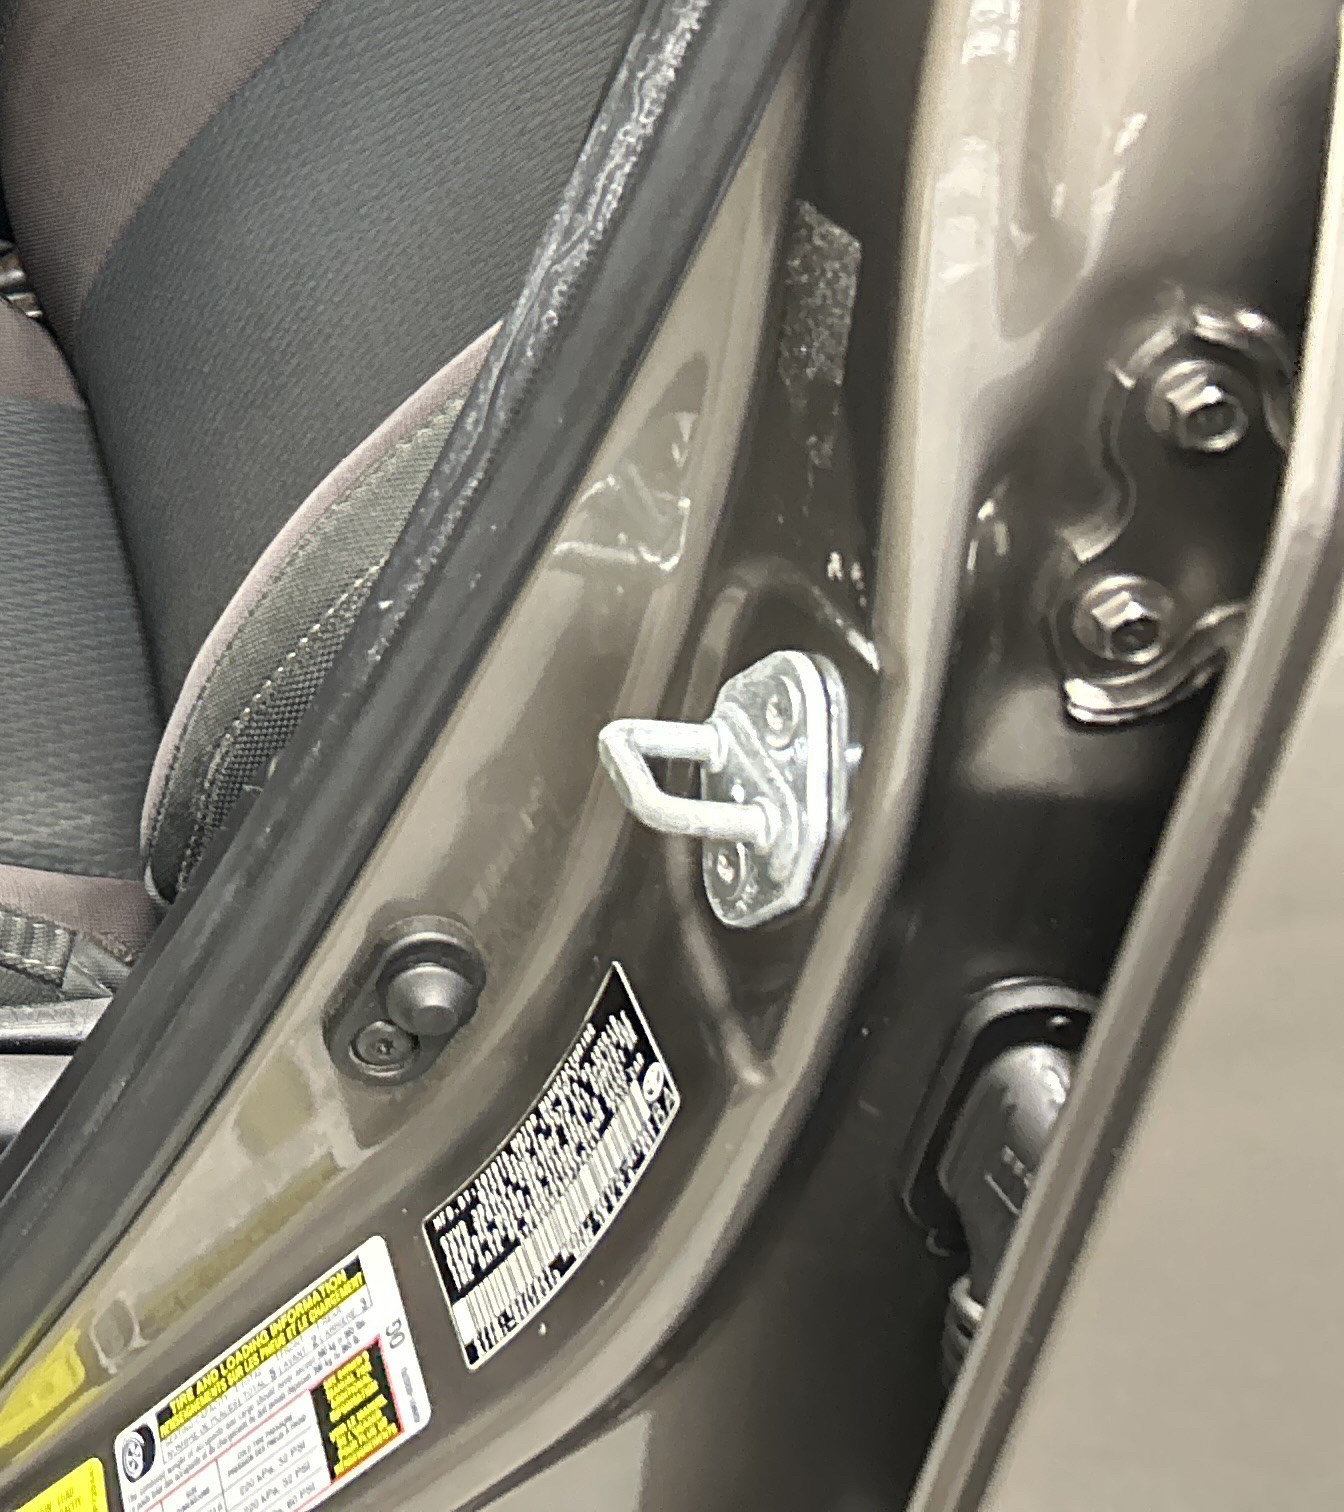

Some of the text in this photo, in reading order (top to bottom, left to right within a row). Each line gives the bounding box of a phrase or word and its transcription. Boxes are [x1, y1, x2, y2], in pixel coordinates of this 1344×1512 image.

[169, 1269, 347, 1414] TIRE AND LOADING INFORMATION
